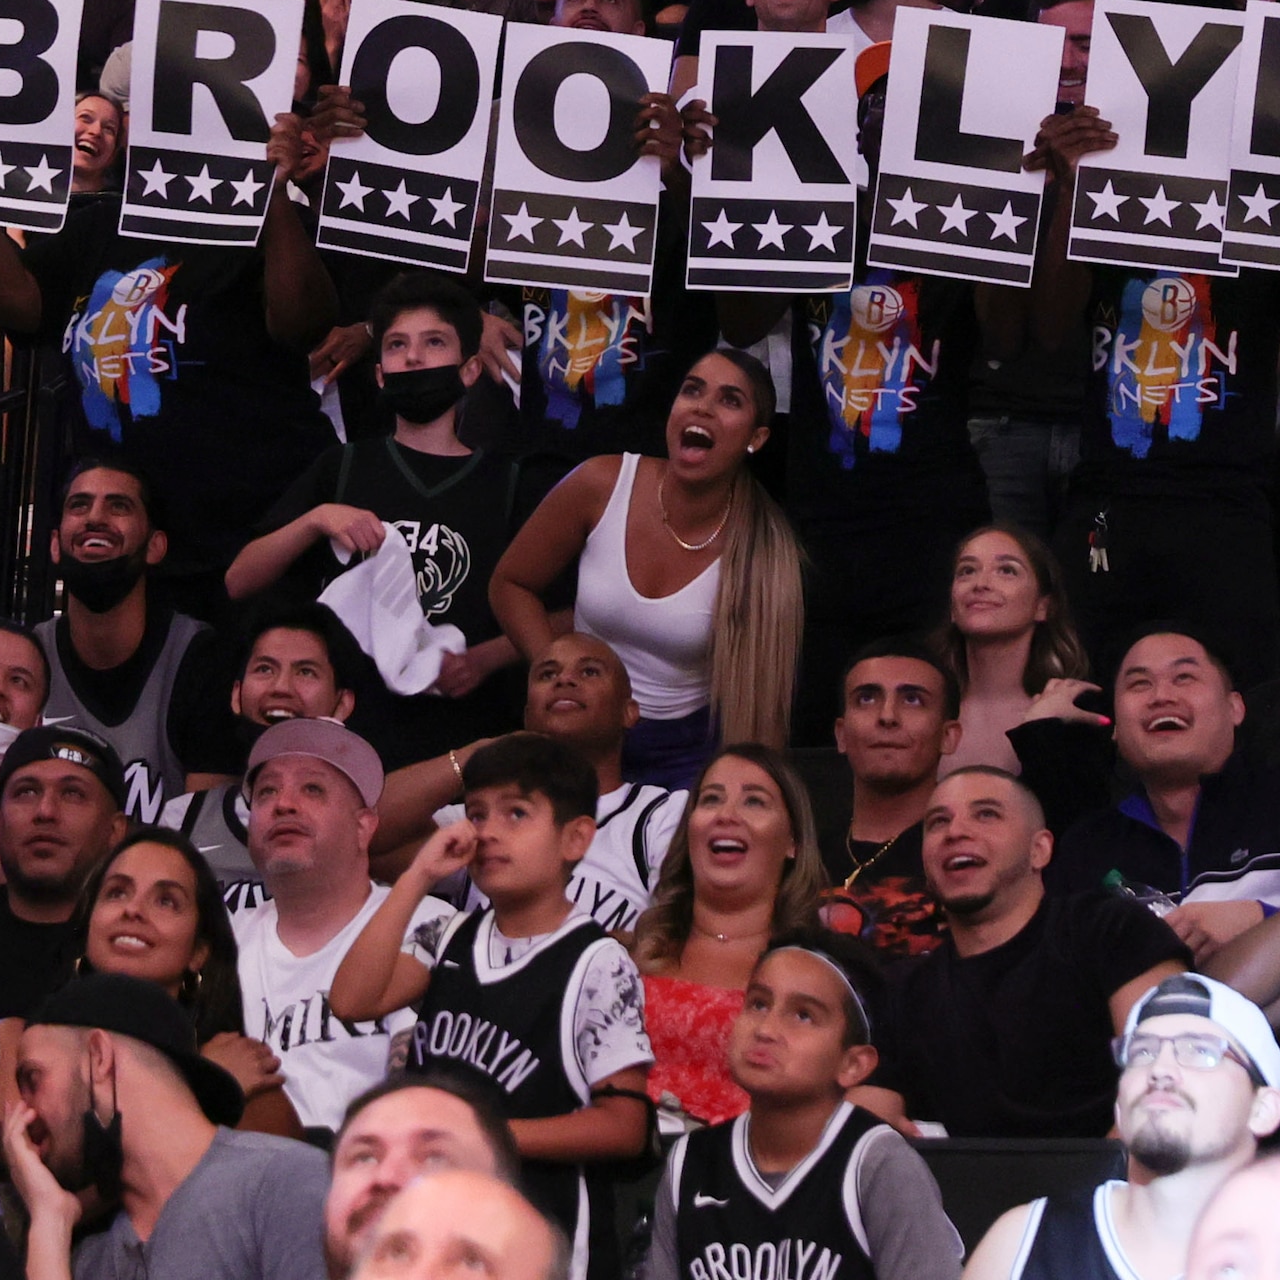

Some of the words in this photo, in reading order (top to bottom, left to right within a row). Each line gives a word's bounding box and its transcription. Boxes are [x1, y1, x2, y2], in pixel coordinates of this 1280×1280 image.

[61, 303, 189, 355] BKLYN
[522, 298, 656, 348] BKLYN
[81, 346, 172, 382] NETS
[547, 336, 641, 381] NETS
[1093, 325, 1239, 377] BKLYN
[824, 380, 922, 414] NETS
[1119, 375, 1221, 411] NETS
